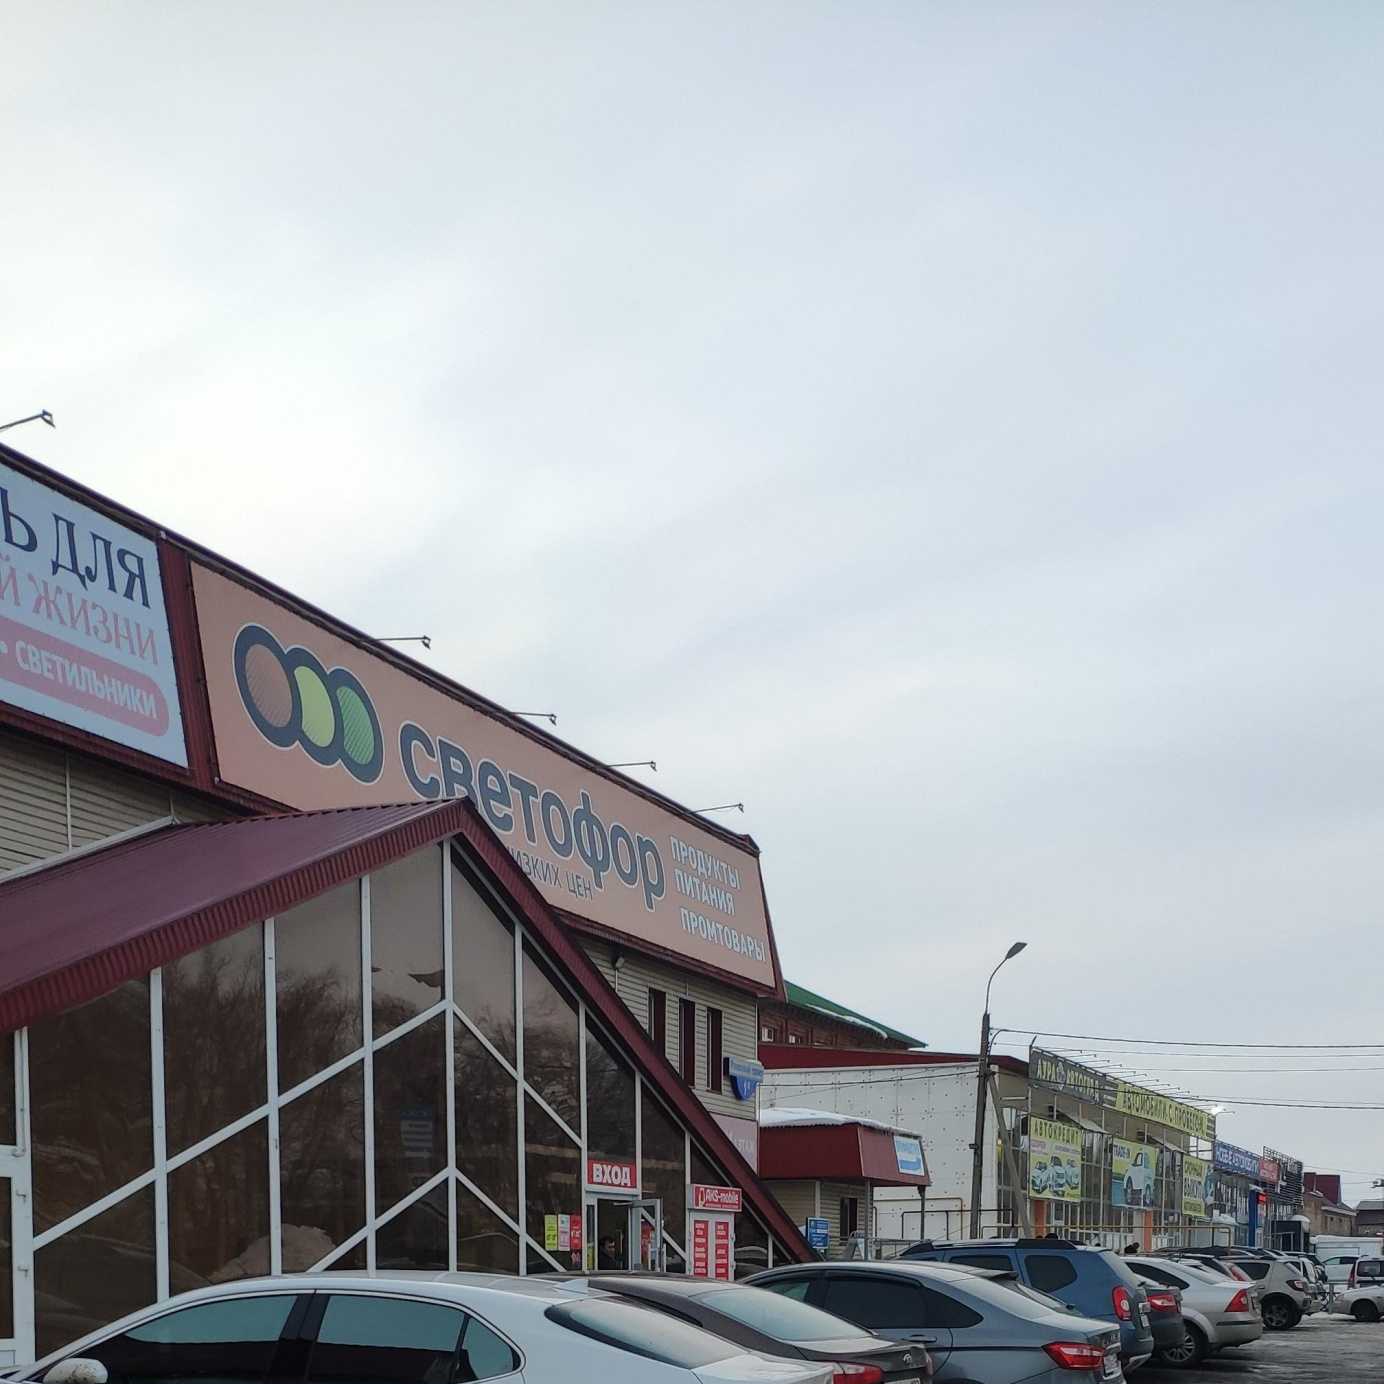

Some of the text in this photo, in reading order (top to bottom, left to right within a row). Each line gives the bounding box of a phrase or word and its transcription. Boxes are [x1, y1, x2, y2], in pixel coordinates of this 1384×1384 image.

[51, 512, 151, 608] ДЛЯ
[27, 572, 158, 665] ЖИЗНИ
[15, 640, 158, 719] СВЕТИЛЬНИКИ
[566, 872, 593, 901] ЦЕН
[670, 836, 741, 890] ПРОДУКТЫ
[674, 868, 736, 916] ПИТАНИЯ
[680, 907, 766, 961] ПРОМТОВАРЫ
[1035, 1119, 1080, 1146] АВТОКРЕДИТ
[593, 1163, 631, 1187] ВХОД
